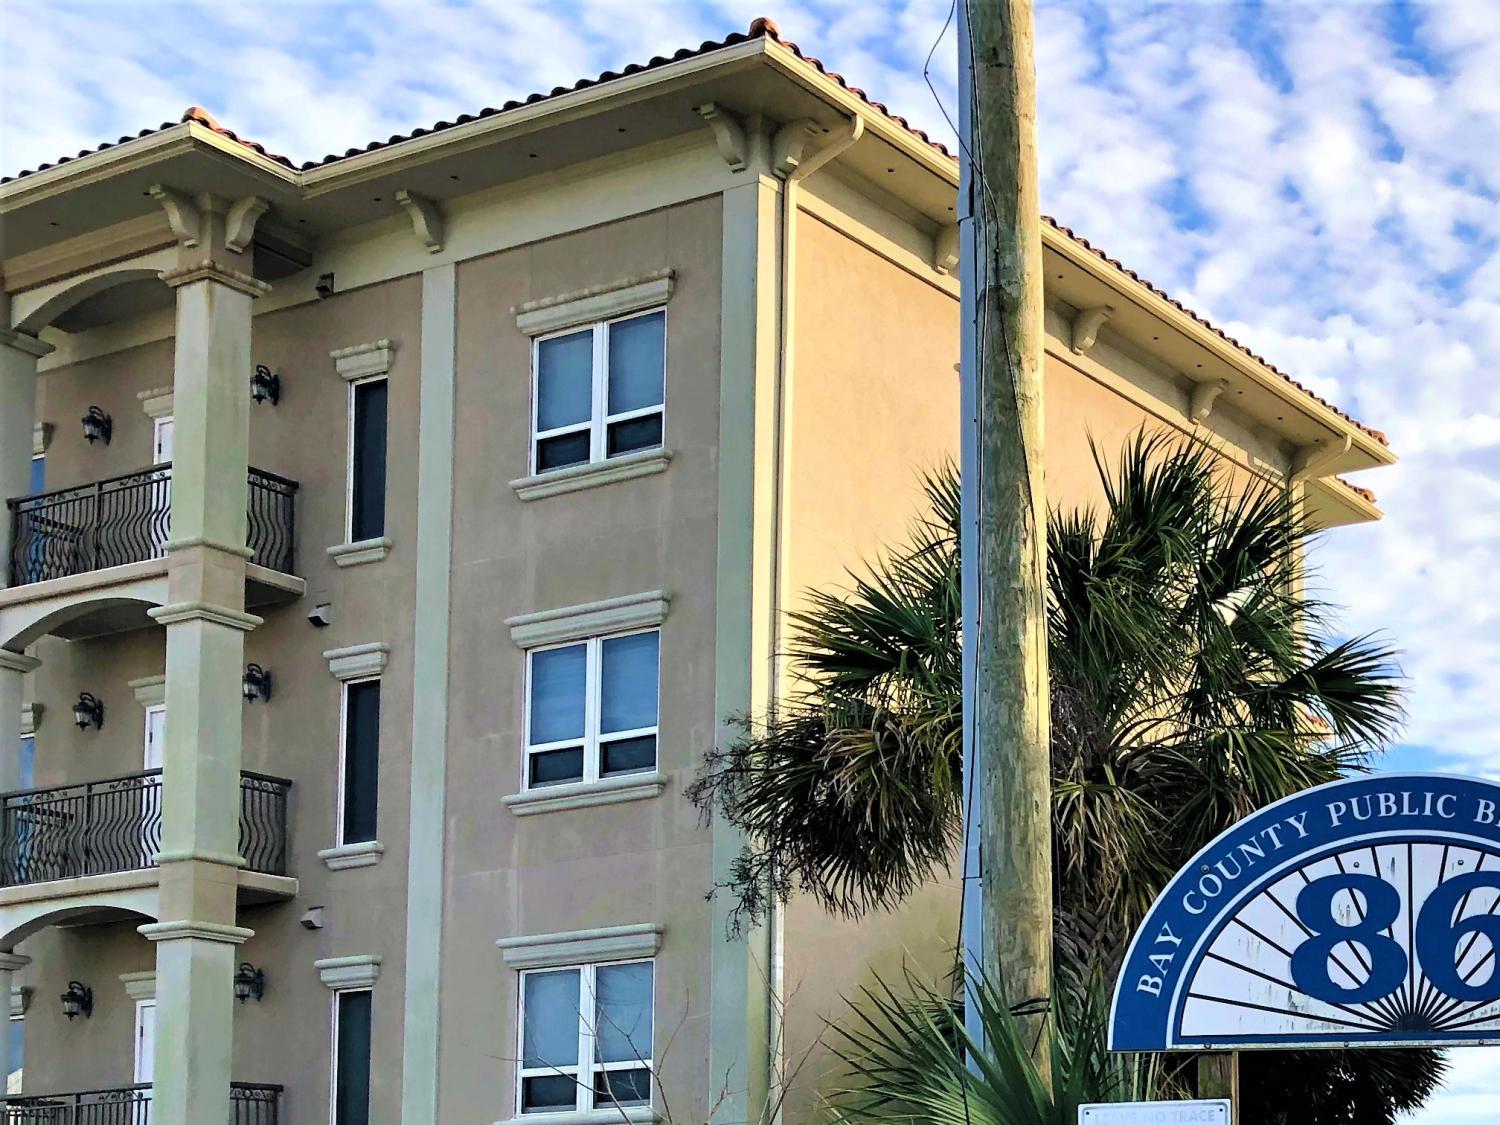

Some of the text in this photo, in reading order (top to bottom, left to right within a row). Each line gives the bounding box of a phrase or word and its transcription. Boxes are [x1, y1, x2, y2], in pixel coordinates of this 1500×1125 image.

[1136, 921, 1183, 998] BAY
[1182, 811, 1309, 915] COUNTY
[1325, 791, 1457, 828] PUBLIC
[1144, 1111, 1166, 1123] NO
[1169, 1109, 1216, 1122] TRACE
